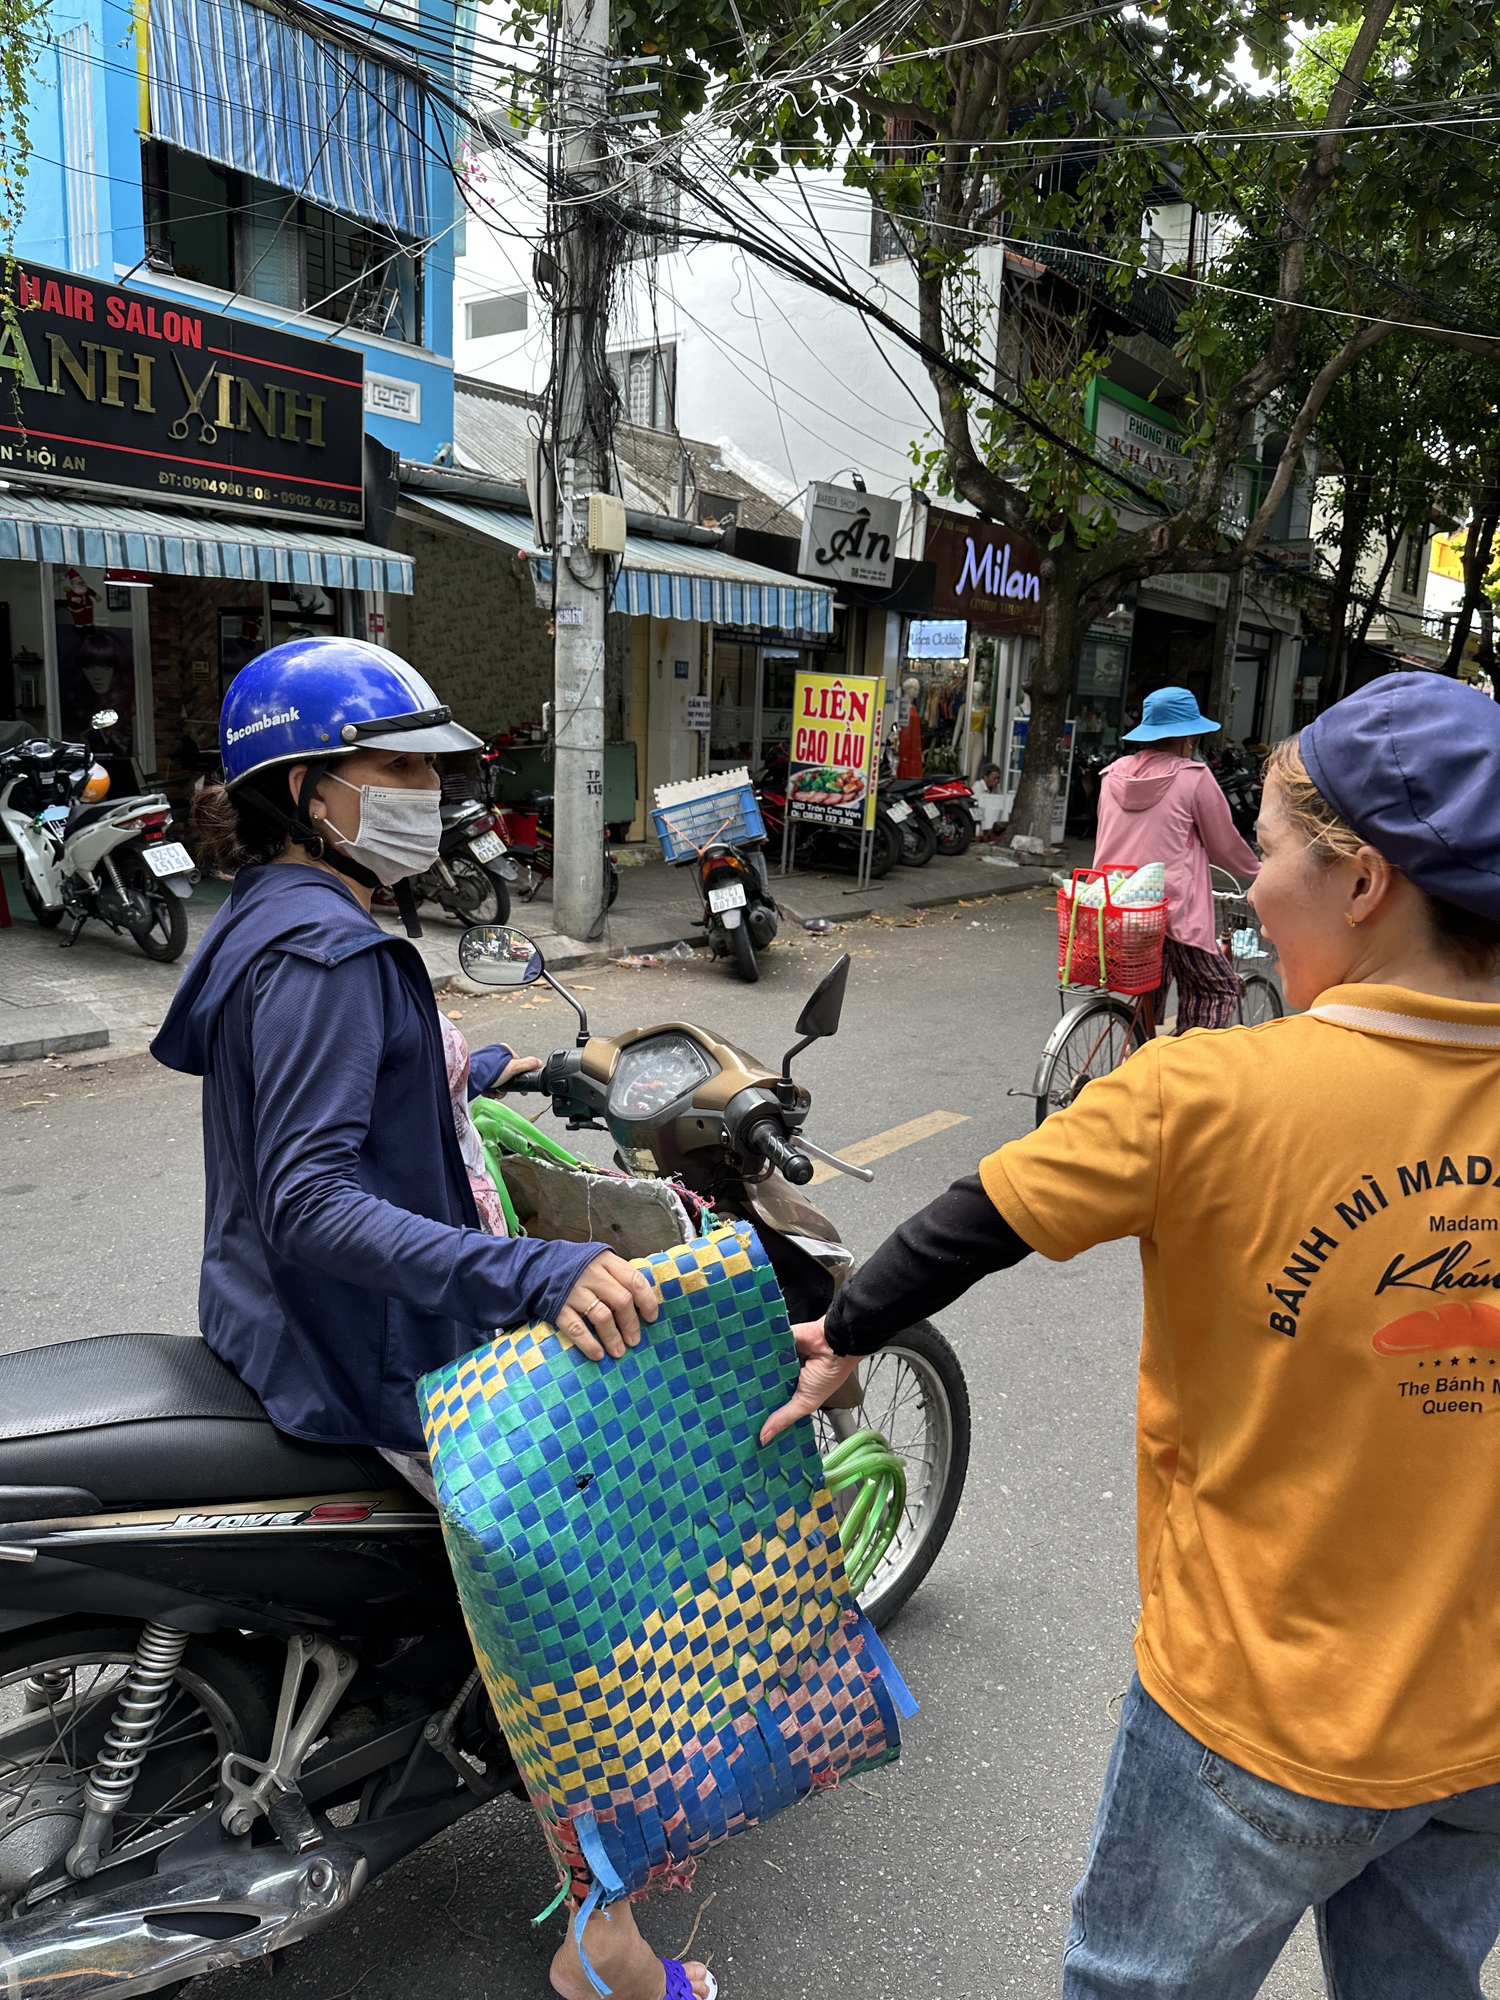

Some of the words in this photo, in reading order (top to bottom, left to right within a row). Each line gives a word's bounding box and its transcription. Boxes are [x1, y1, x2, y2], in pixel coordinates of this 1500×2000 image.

[19, 273, 94, 323] HAIR
[106, 296, 202, 349] SALON
[62, 455, 86, 472] AN
[815, 507, 891, 566] Ân
[955, 537, 1040, 603] Milan
[932, 632, 963, 650] Clothing
[803, 680, 869, 723] LIÊN
[226, 706, 300, 746] Sacombank
[795, 727, 829, 765] CAO
[833, 722, 865, 769] LẦU
[586, 770, 601, 781] TP
[792, 801, 806, 811] 120
[827, 807, 843, 816] Cao
[1430, 1215, 1499, 1232] Madam
[1266, 1226, 1339, 1338] BÁNH
[1334, 1174, 1389, 1231] MÌ
[1398, 1381, 1431, 1397] The
[1435, 1376, 1485, 1393] Bánh
[1422, 1399, 1483, 1415] Queen
[165, 1512, 303, 1531] Wave
